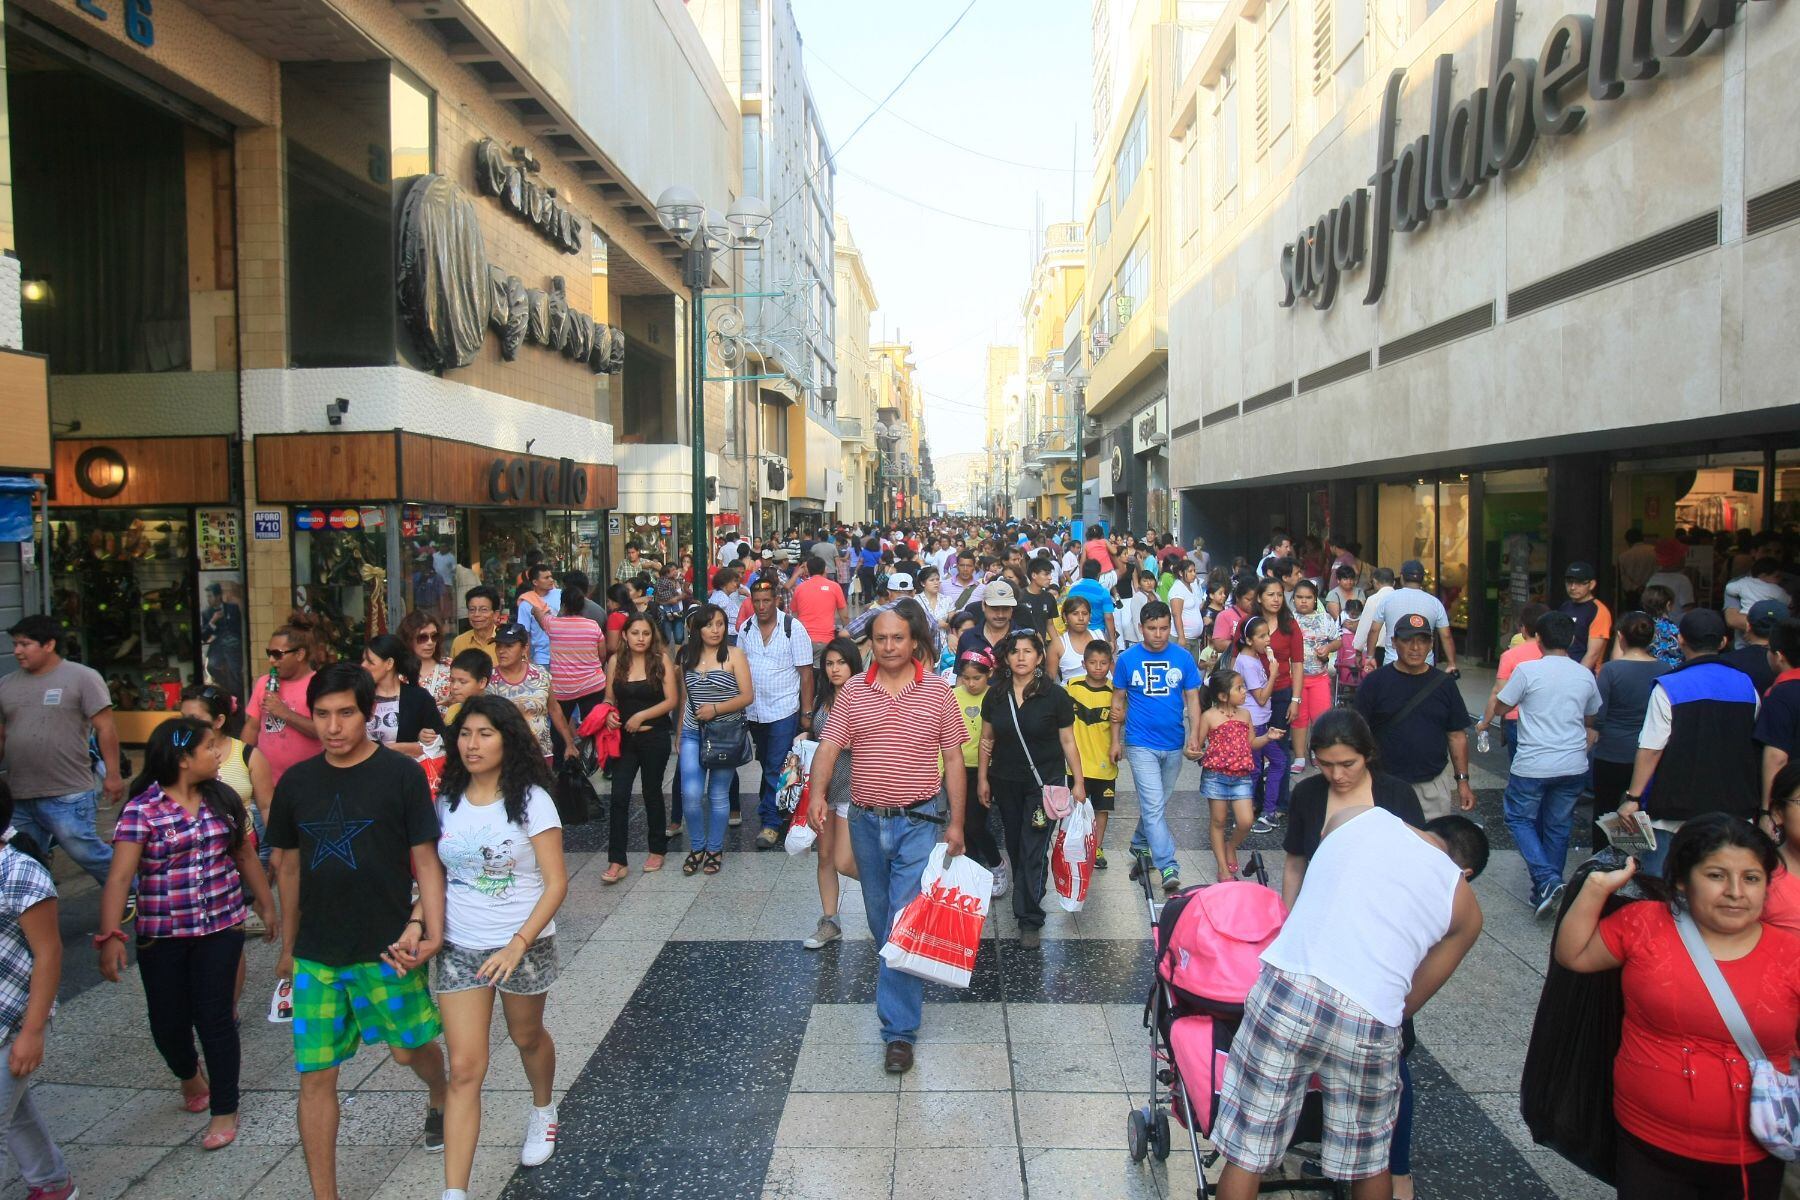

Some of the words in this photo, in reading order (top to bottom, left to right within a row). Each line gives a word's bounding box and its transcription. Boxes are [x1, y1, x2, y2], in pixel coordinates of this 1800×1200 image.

[1278, 187, 1368, 311] saga
[489, 457, 588, 505] corello
[255, 513, 280, 521] AFORO
[258, 521, 280, 532] 710
